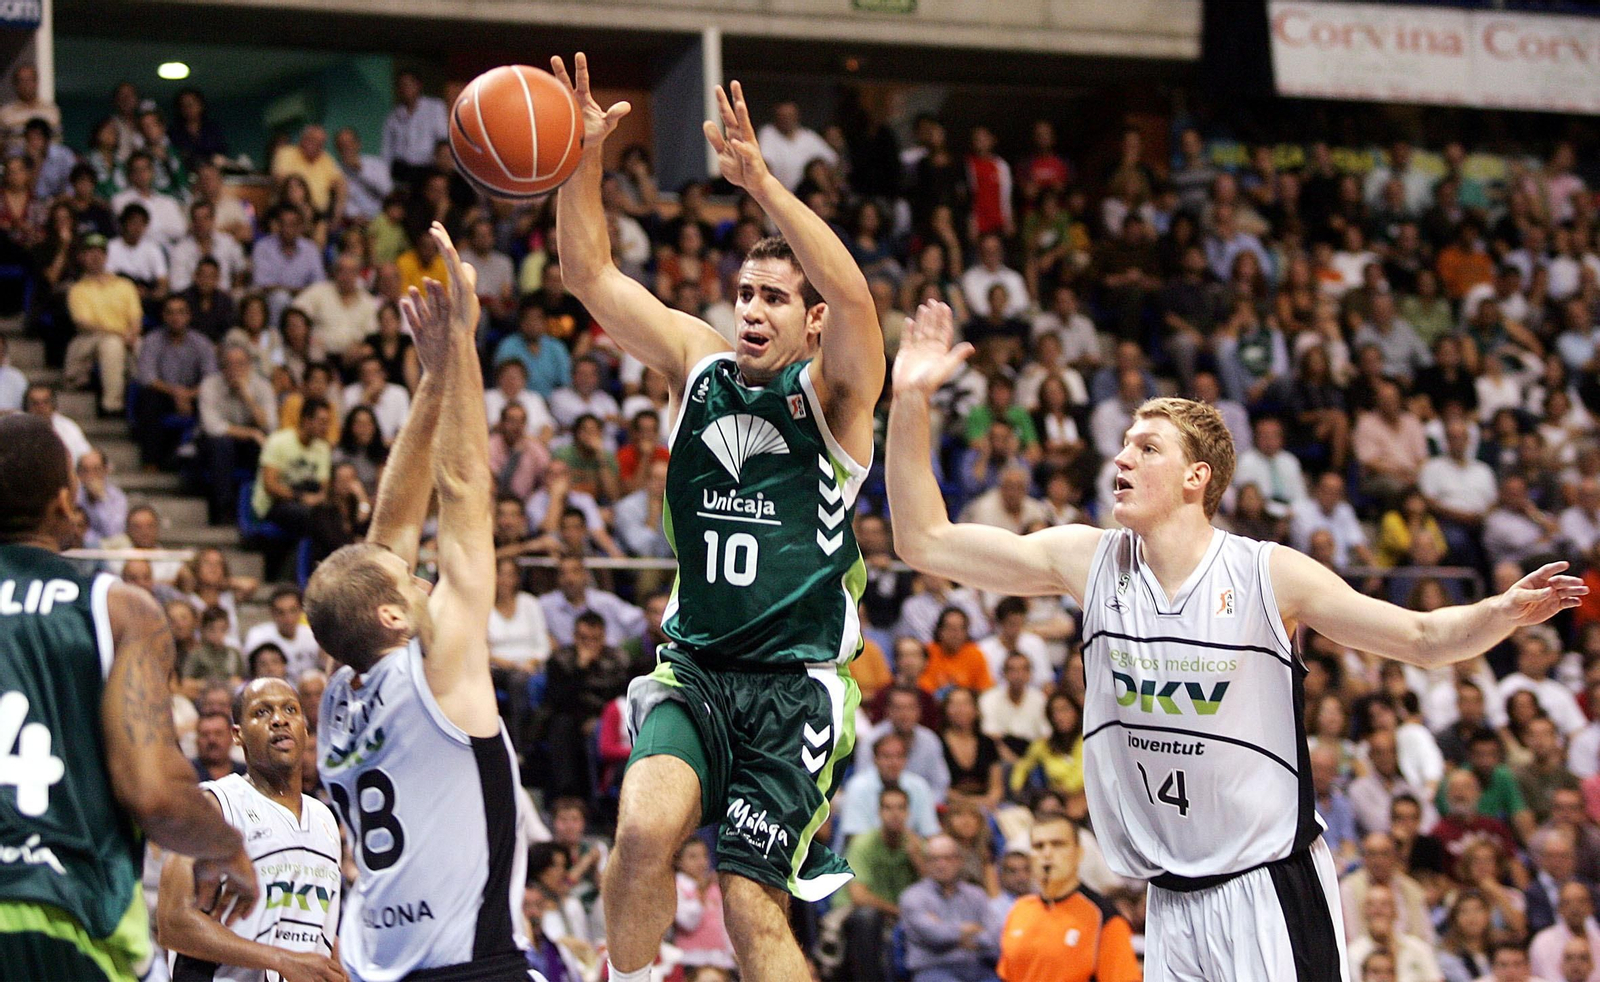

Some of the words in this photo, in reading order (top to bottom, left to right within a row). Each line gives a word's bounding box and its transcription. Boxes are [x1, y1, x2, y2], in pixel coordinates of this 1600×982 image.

[0, 0, 40, 21] om
[1273, 8, 1464, 57] Corvina
[1481, 21, 1600, 62] Corv
[703, 488, 776, 519] Unicaja
[703, 529, 759, 587] 10
[0, 578, 80, 616] LIP
[1110, 649, 1159, 670] eguros
[1165, 656, 1237, 673] médicos
[1112, 669, 1231, 716] DKV
[726, 798, 788, 859] Málaga
